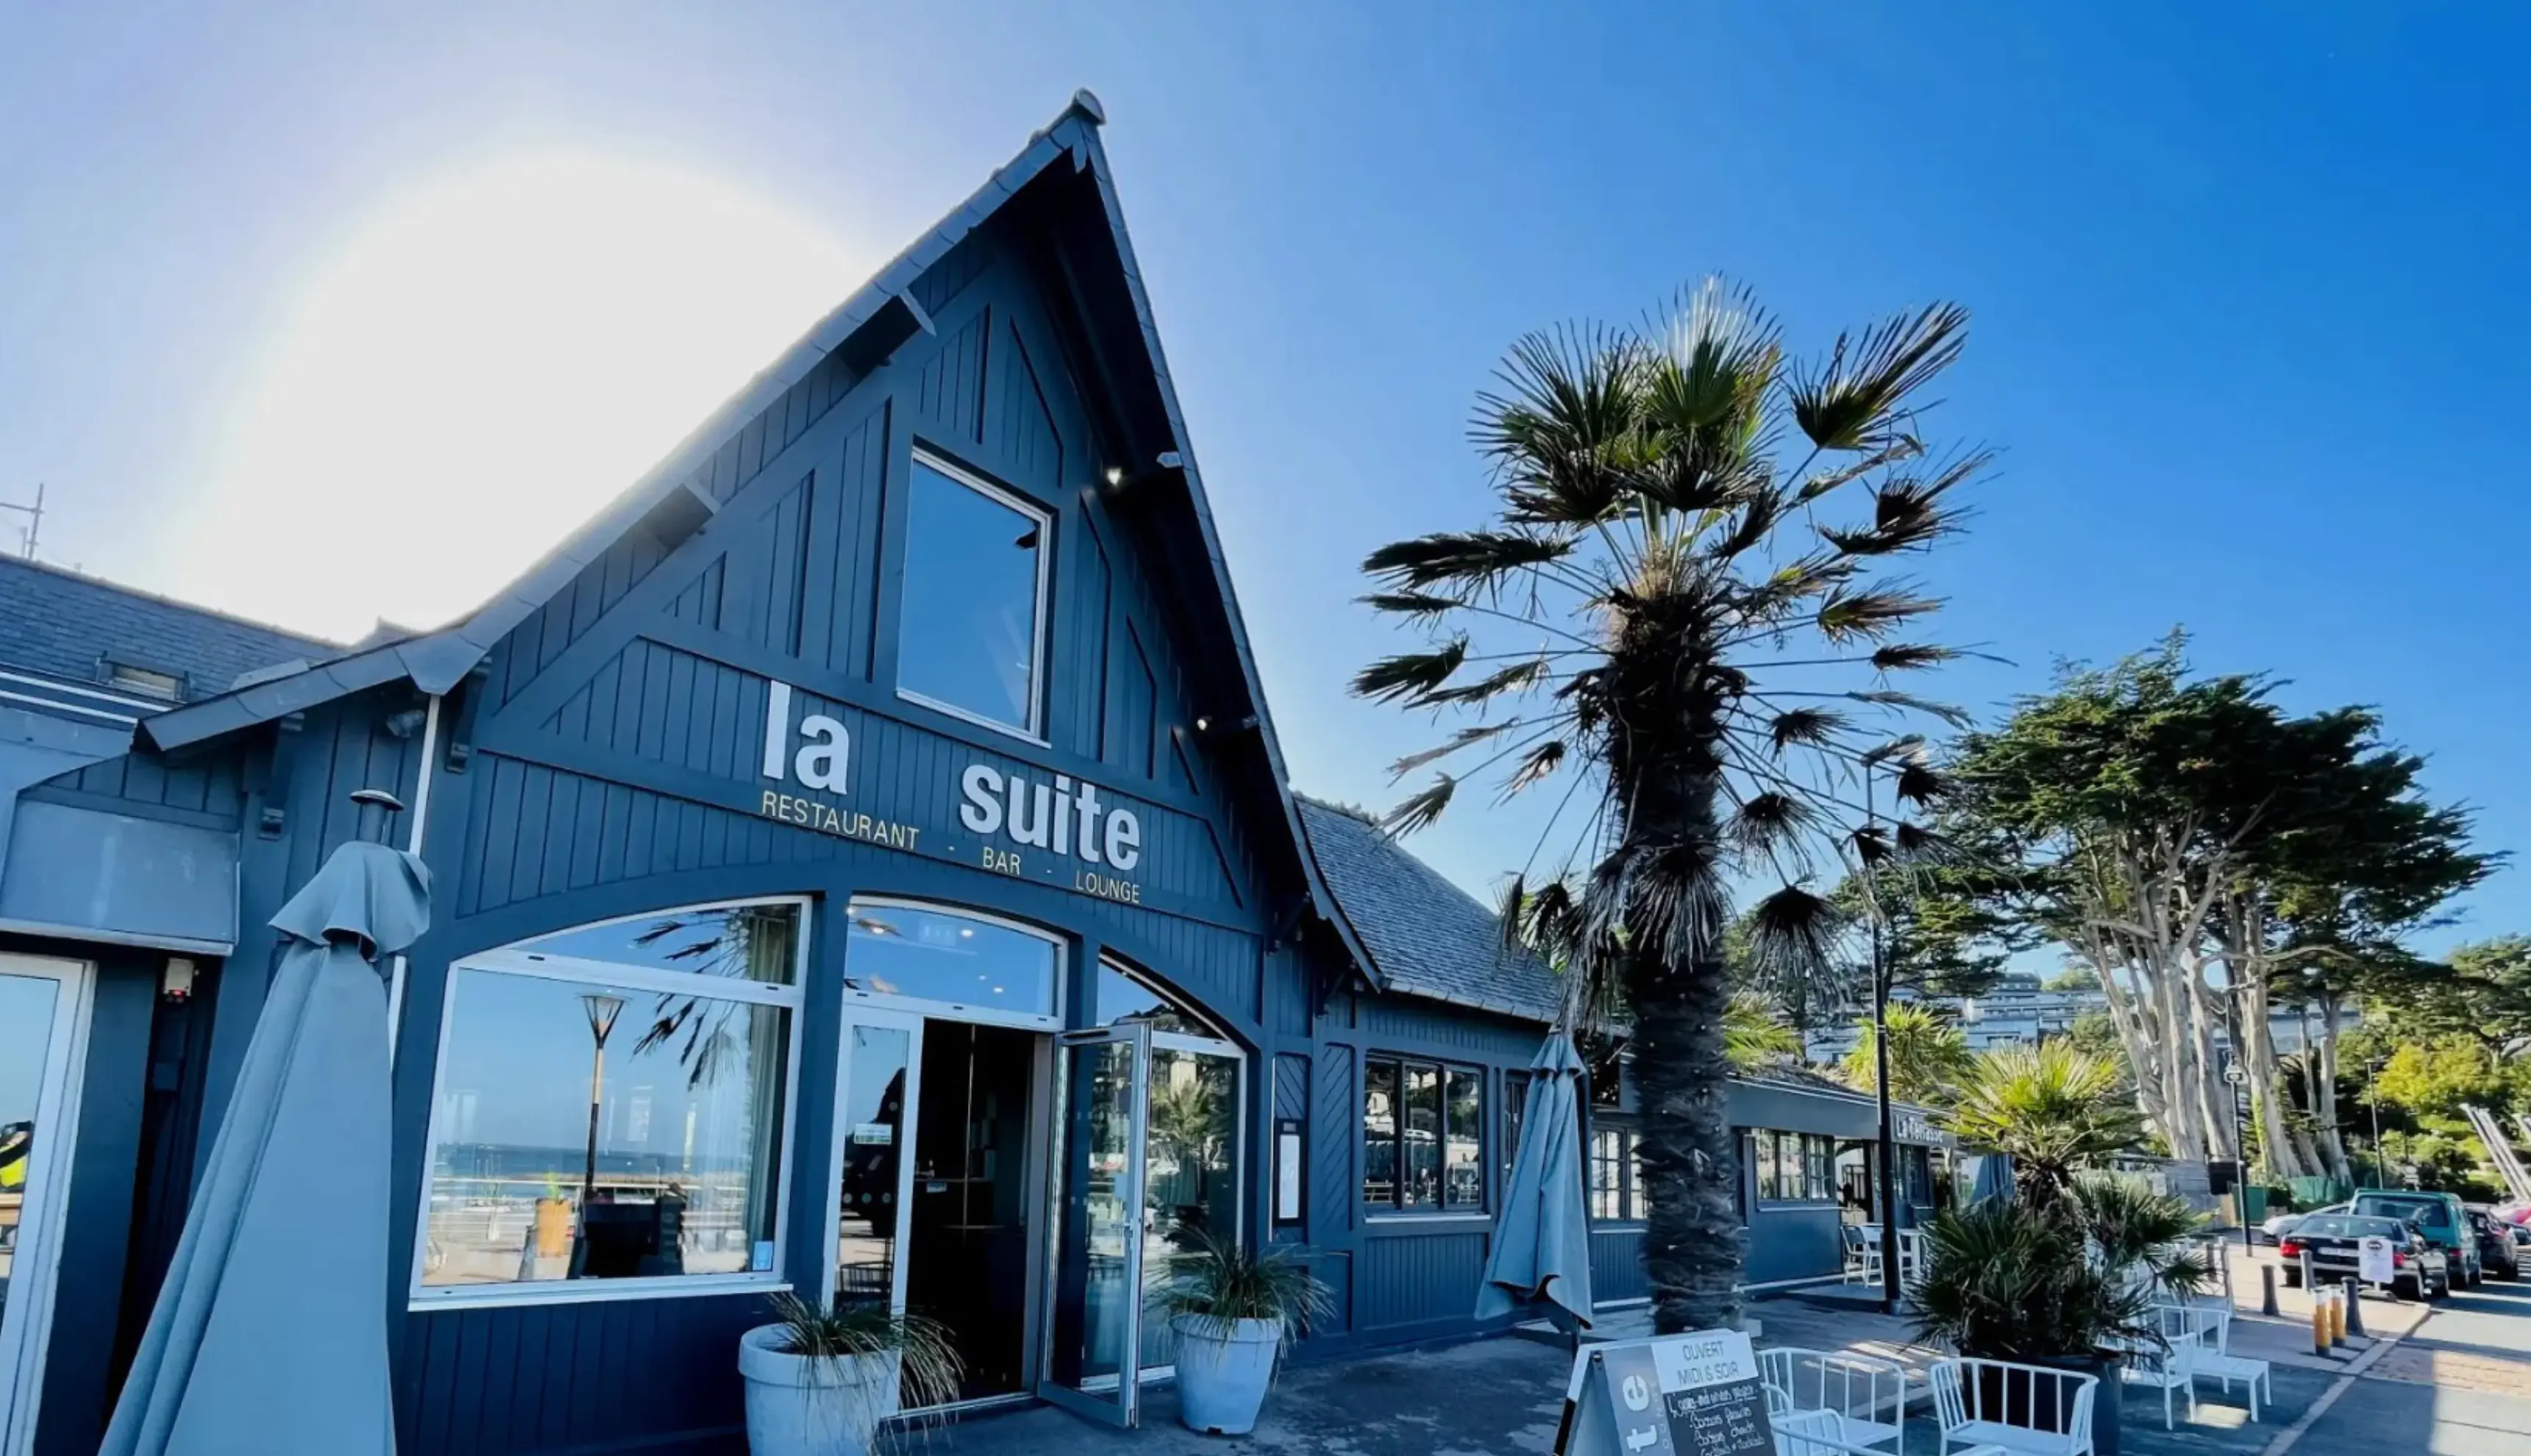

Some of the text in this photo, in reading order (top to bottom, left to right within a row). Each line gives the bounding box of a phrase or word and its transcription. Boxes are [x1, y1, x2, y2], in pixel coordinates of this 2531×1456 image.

[762, 679, 1140, 871] la suite
[762, 790, 919, 852] RESTAURANT
[983, 846, 1021, 875] BAR
[1075, 870, 1140, 904] LOUNGE
[1896, 1114, 1907, 1138] La
[1682, 1341, 1724, 1361] OUVERT
[1677, 1367, 1704, 1385] MIDI
[1715, 1360, 1739, 1380] SOIR
